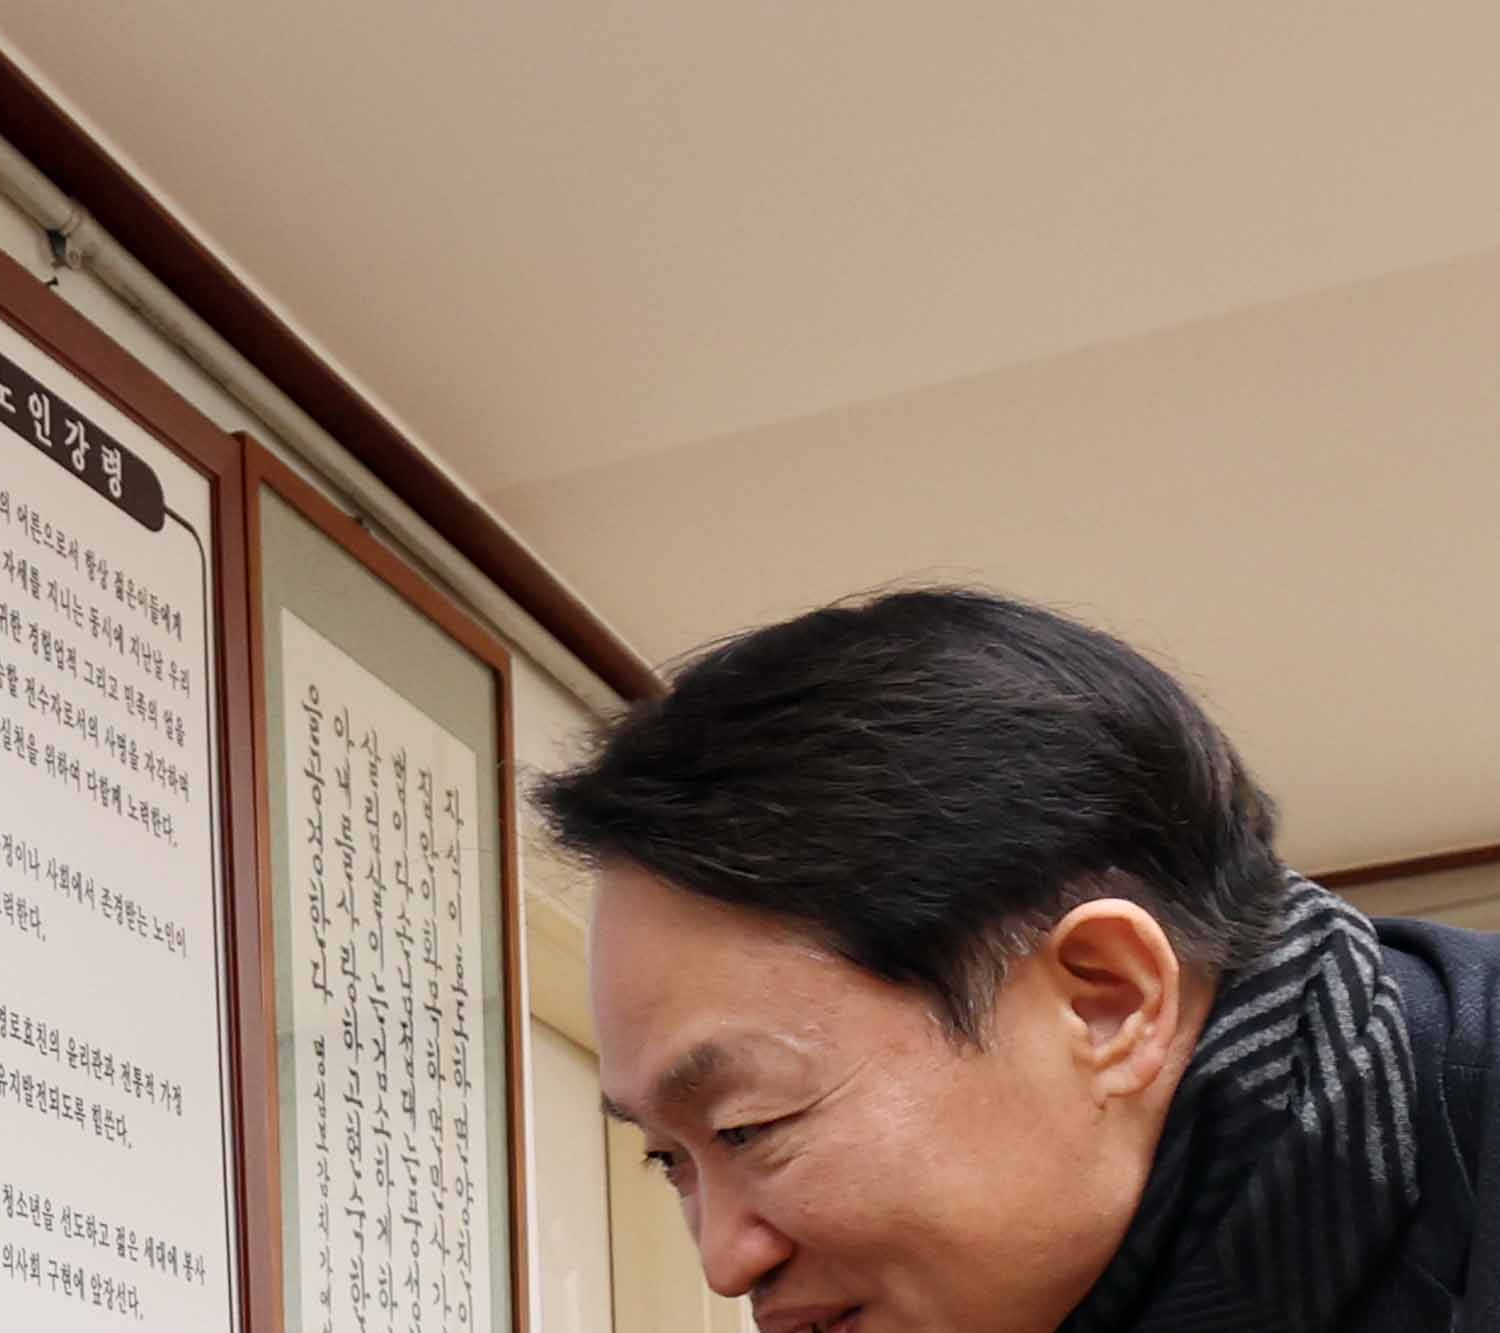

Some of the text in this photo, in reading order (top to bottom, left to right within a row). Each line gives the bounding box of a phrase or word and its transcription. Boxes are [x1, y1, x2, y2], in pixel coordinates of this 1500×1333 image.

[46, 857, 95, 911] 사회에서
[152, 915, 187, 960] 노인이
[120, 1060, 155, 1105] 전통적
[3, 1184, 55, 1232] 청소년을
[60, 1205, 111, 1249] 선도하고
[143, 1236, 178, 1277] 세대에
[48, 1259, 86, 1301] 구현에
